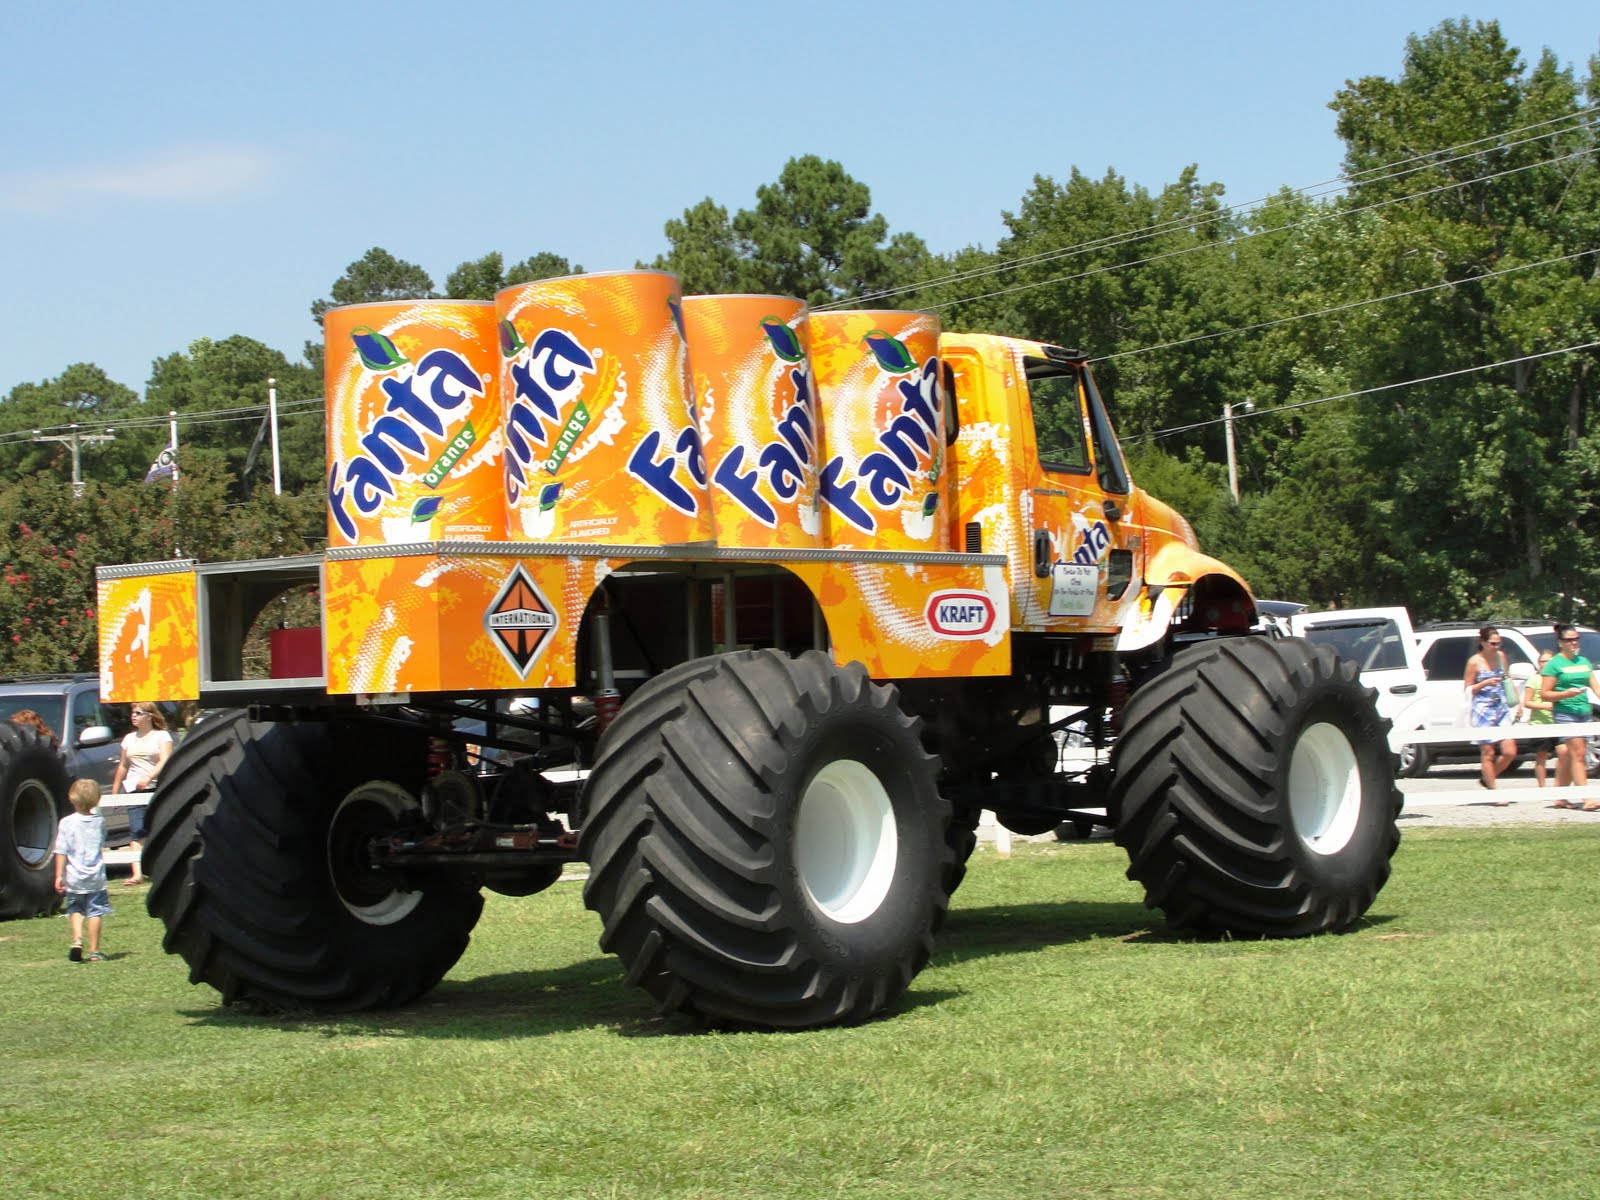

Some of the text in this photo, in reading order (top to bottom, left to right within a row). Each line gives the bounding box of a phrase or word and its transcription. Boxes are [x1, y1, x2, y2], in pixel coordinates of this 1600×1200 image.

[328, 349, 484, 541] Fanta
[504, 328, 596, 507] anta
[545, 406, 588, 471] orange
[426, 428, 474, 485] orange
[940, 606, 984, 623] KRAFT
